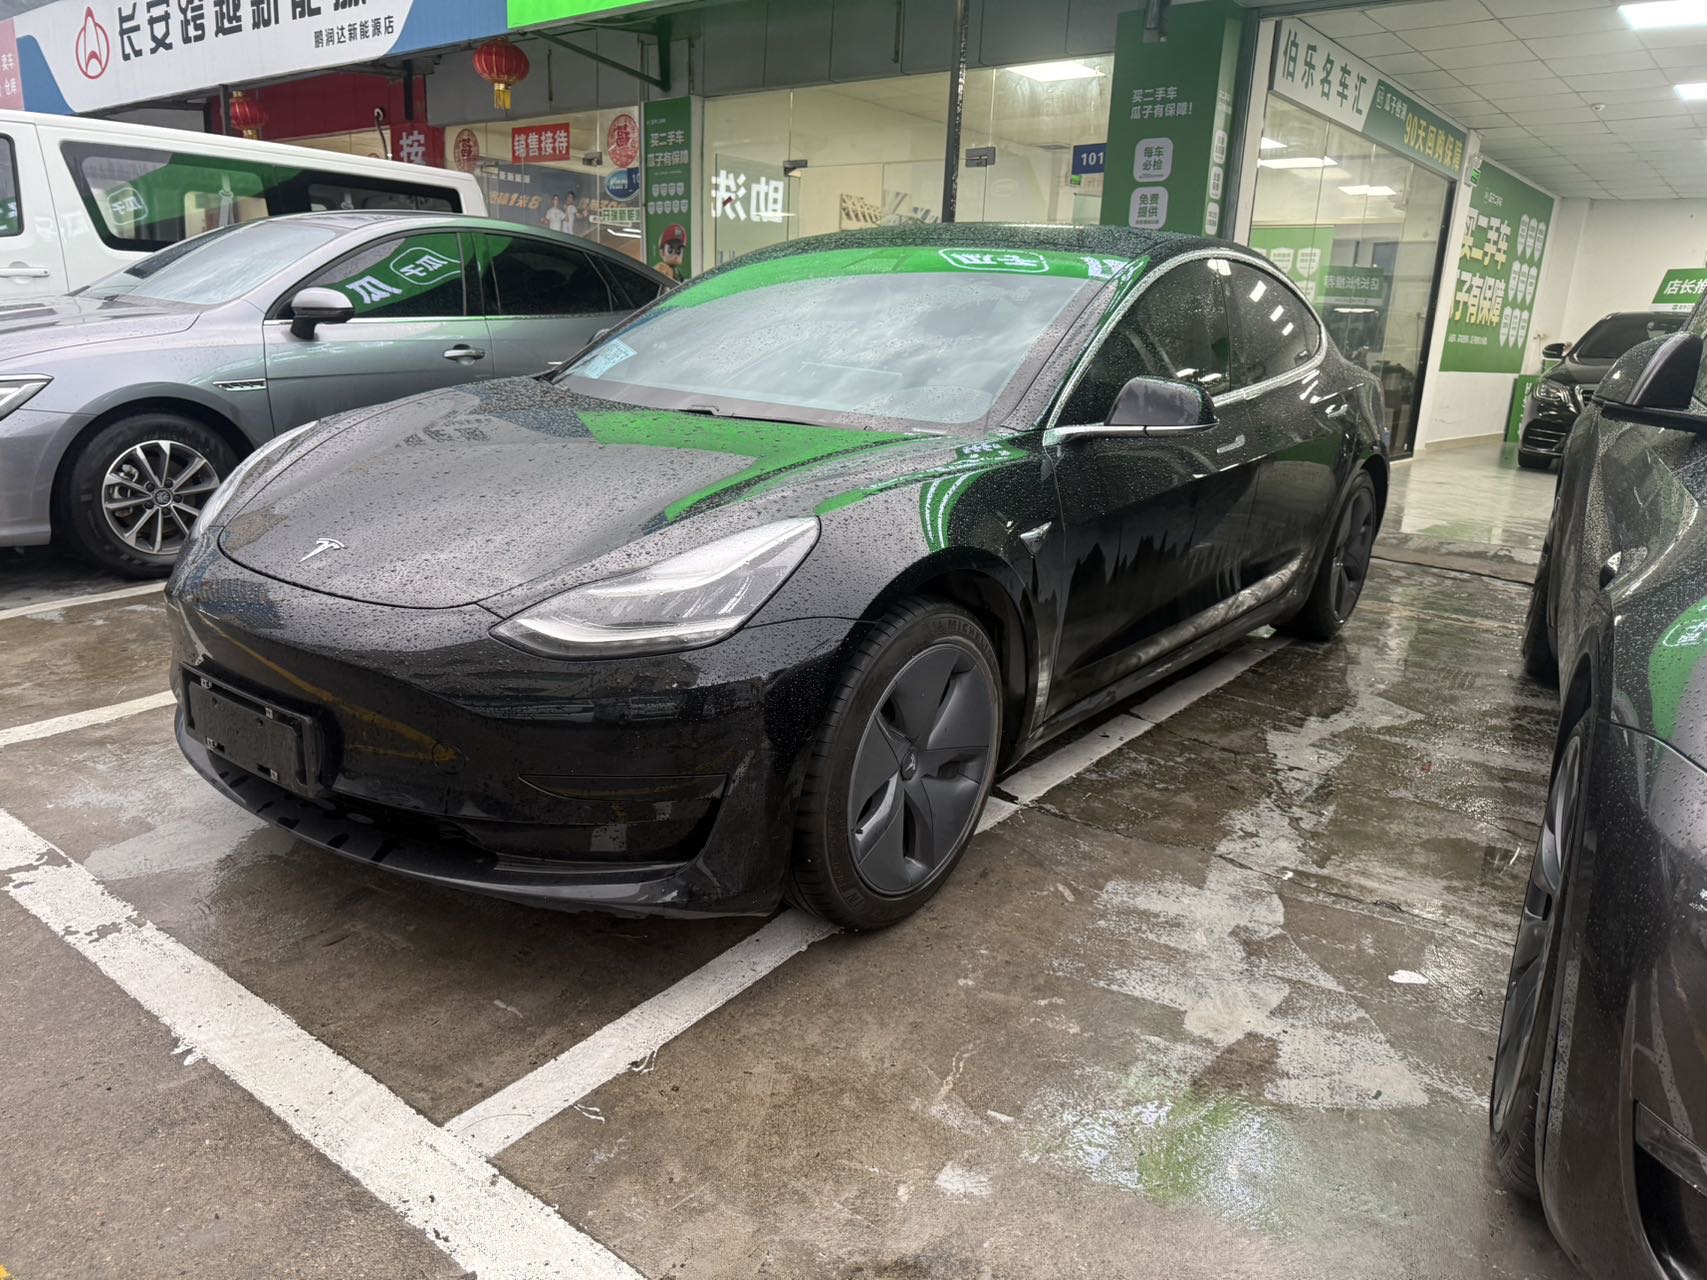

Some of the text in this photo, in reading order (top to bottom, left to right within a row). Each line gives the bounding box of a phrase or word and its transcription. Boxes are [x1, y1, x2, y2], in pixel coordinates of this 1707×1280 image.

[313, 15, 395, 49] 鹏润达新能源店
[1282, 28, 1367, 116] 伯乐名车汇
[1131, 86, 1178, 103] 买二手车
[513, 129, 568, 159] 销售接待
[650, 130, 685, 147] 买二手车
[1449, 268, 1506, 328] 子有保障
